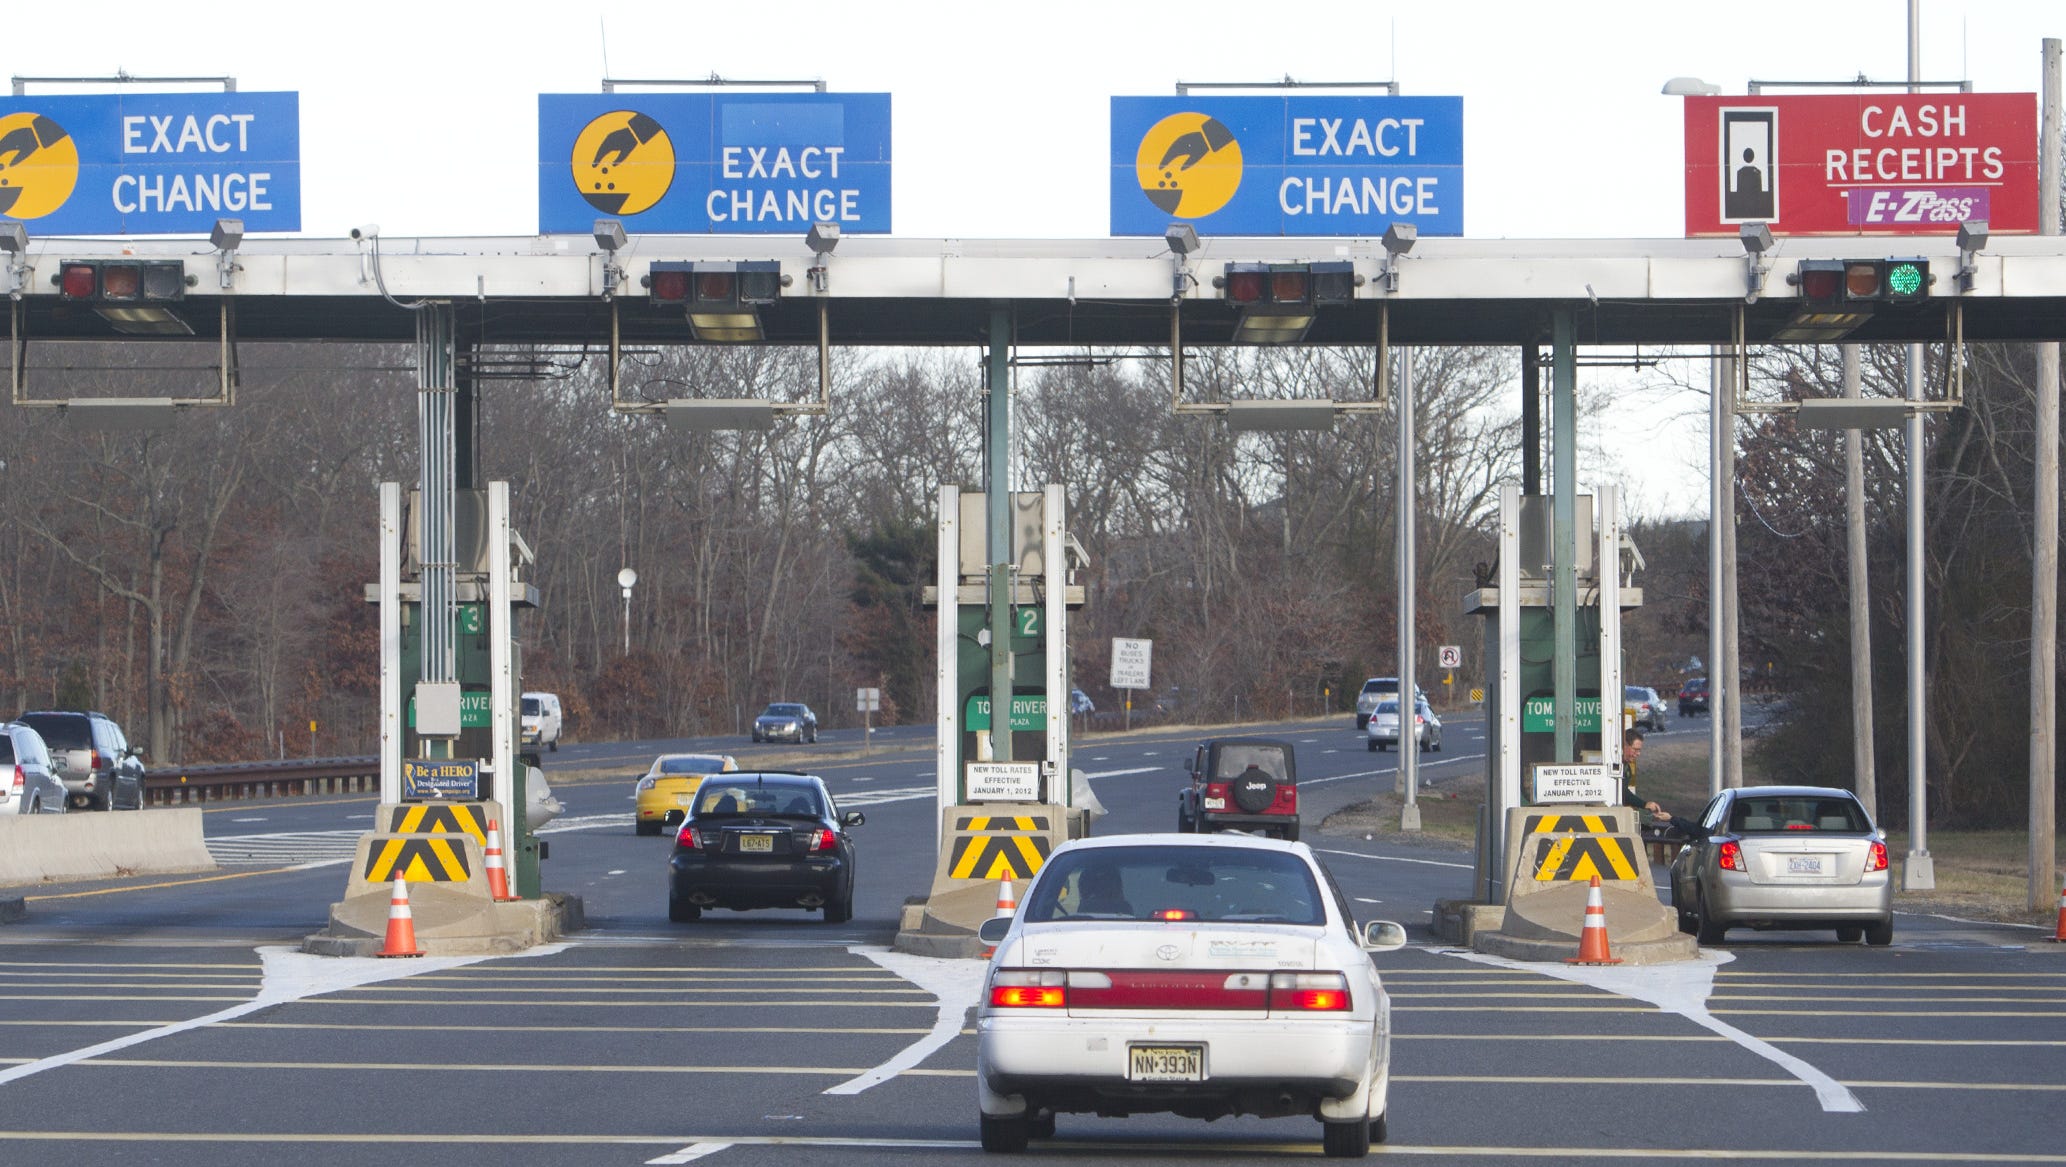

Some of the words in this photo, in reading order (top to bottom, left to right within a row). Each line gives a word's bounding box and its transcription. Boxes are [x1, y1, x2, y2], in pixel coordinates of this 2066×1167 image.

[124, 114, 255, 153] EXACT
[1861, 105, 1966, 138] CASH
[1293, 118, 1425, 156] EXACT
[722, 147, 844, 179] EXACT
[1826, 147, 2004, 181] RECEIPTS
[112, 173, 273, 213] CHANGE
[706, 189, 861, 222] CHANGE
[1279, 177, 1439, 215] CHANGE
[1866, 191, 1973, 222] E-ZPass
[468, 607, 481, 631] 3
[1023, 610, 1037, 635] 2
[977, 701, 991, 714] TO
[1527, 702, 1554, 715] TOM
[416, 765, 429, 777] Be
[431, 768, 438, 777] a
[440, 765, 473, 777] HERO
[973, 766, 989, 774] NEW
[991, 766, 1008, 774] TOLL
[1009, 766, 1032, 774] RATES
[1543, 768, 1558, 776] NEW
[1560, 768, 1578, 776] TOLL
[1007, 788, 1013, 796] 1,
[1246, 781, 1267, 791] Jeep
[1543, 789, 1574, 797] JANUARY
